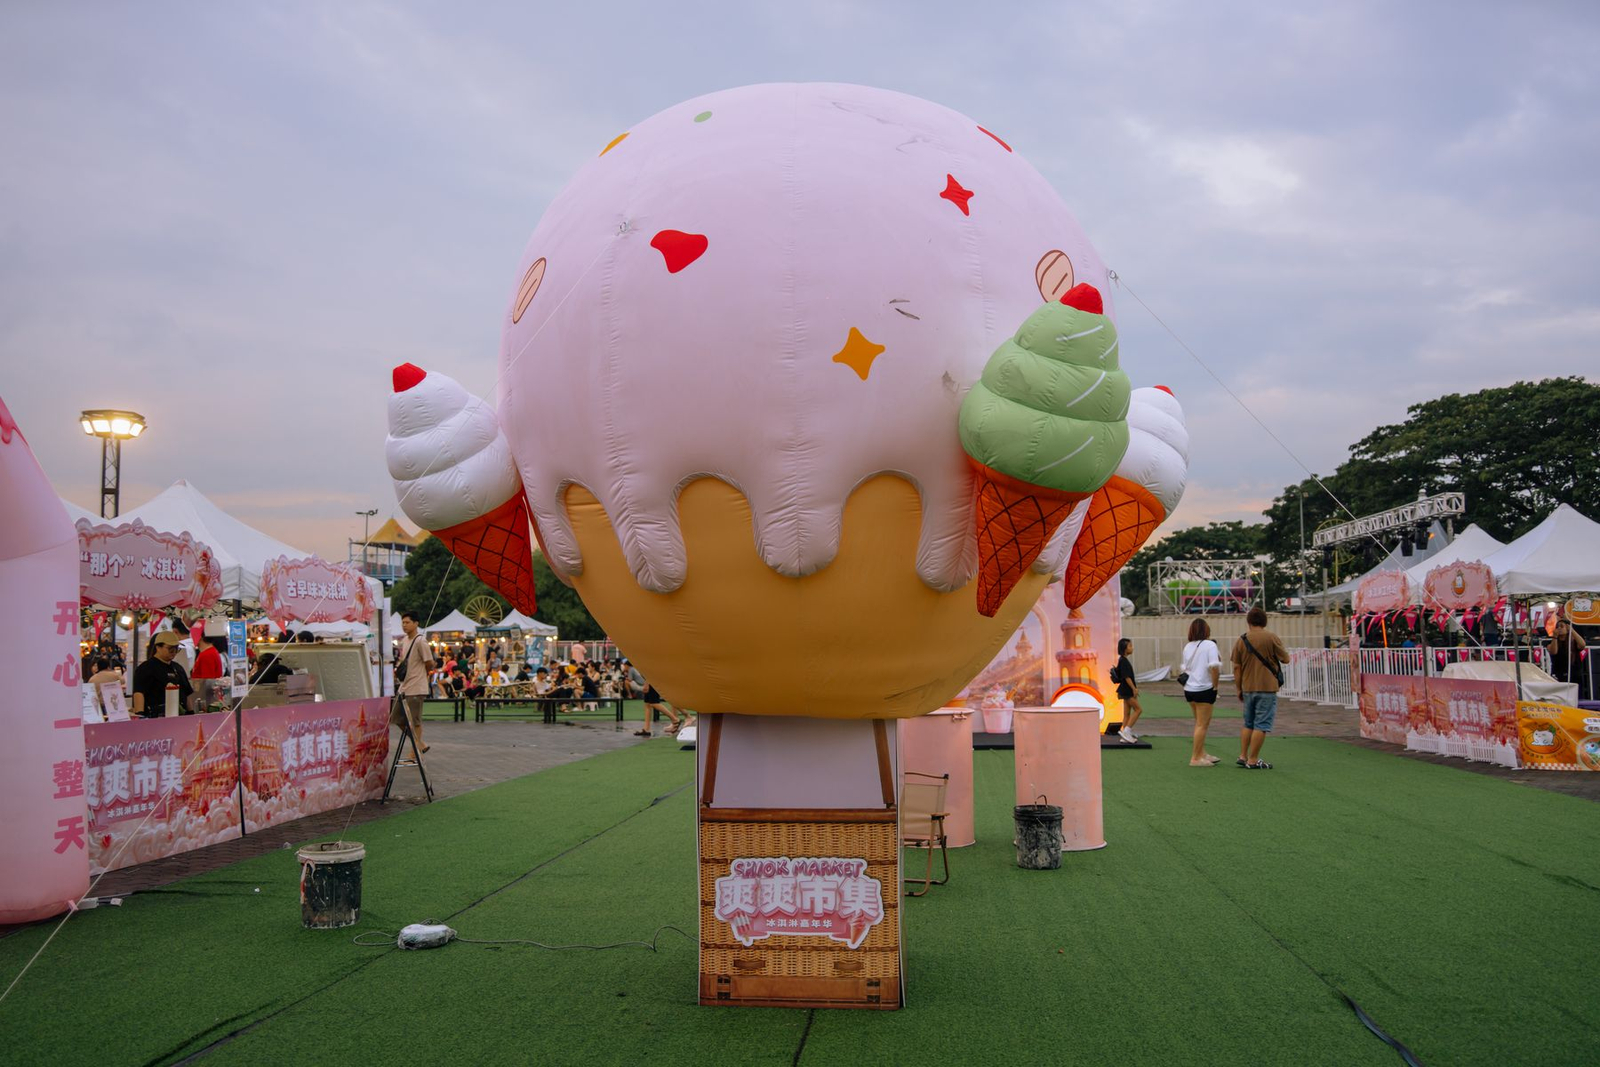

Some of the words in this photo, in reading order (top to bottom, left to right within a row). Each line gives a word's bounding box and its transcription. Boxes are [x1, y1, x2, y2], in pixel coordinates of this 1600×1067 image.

[141, 556, 187, 581] 冰淇淋
[287, 579, 348, 600] 古早味冰淇淋
[53, 601, 86, 854] 开心一整天
[127, 738, 173, 756] MARKET
[282, 730, 349, 772] 爽爽市集
[733, 859, 789, 879] SHIOK
[792, 859, 864, 878] MARKET
[718, 877, 880, 919] 爽爽市集
